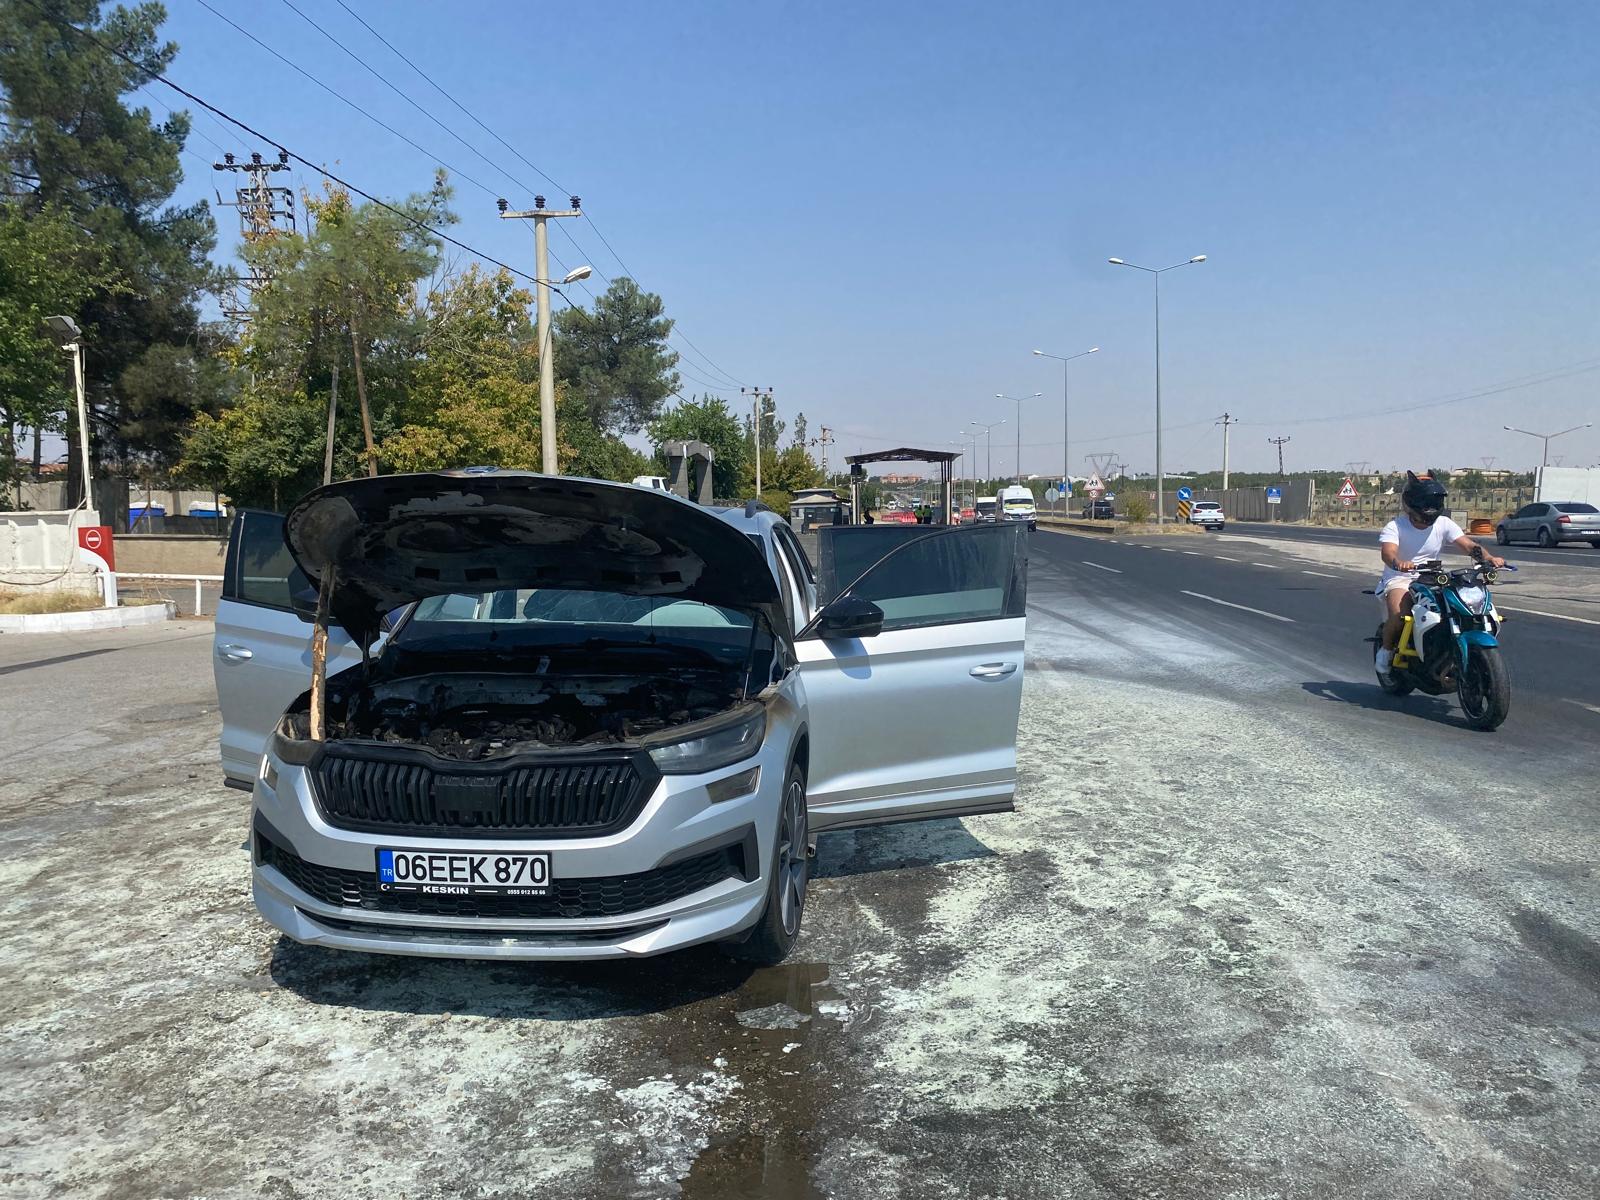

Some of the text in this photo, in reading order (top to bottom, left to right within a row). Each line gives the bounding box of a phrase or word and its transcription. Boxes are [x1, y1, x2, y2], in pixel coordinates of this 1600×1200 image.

[382, 868, 393, 877] TR
[394, 854, 546, 884] 06EEK 870
